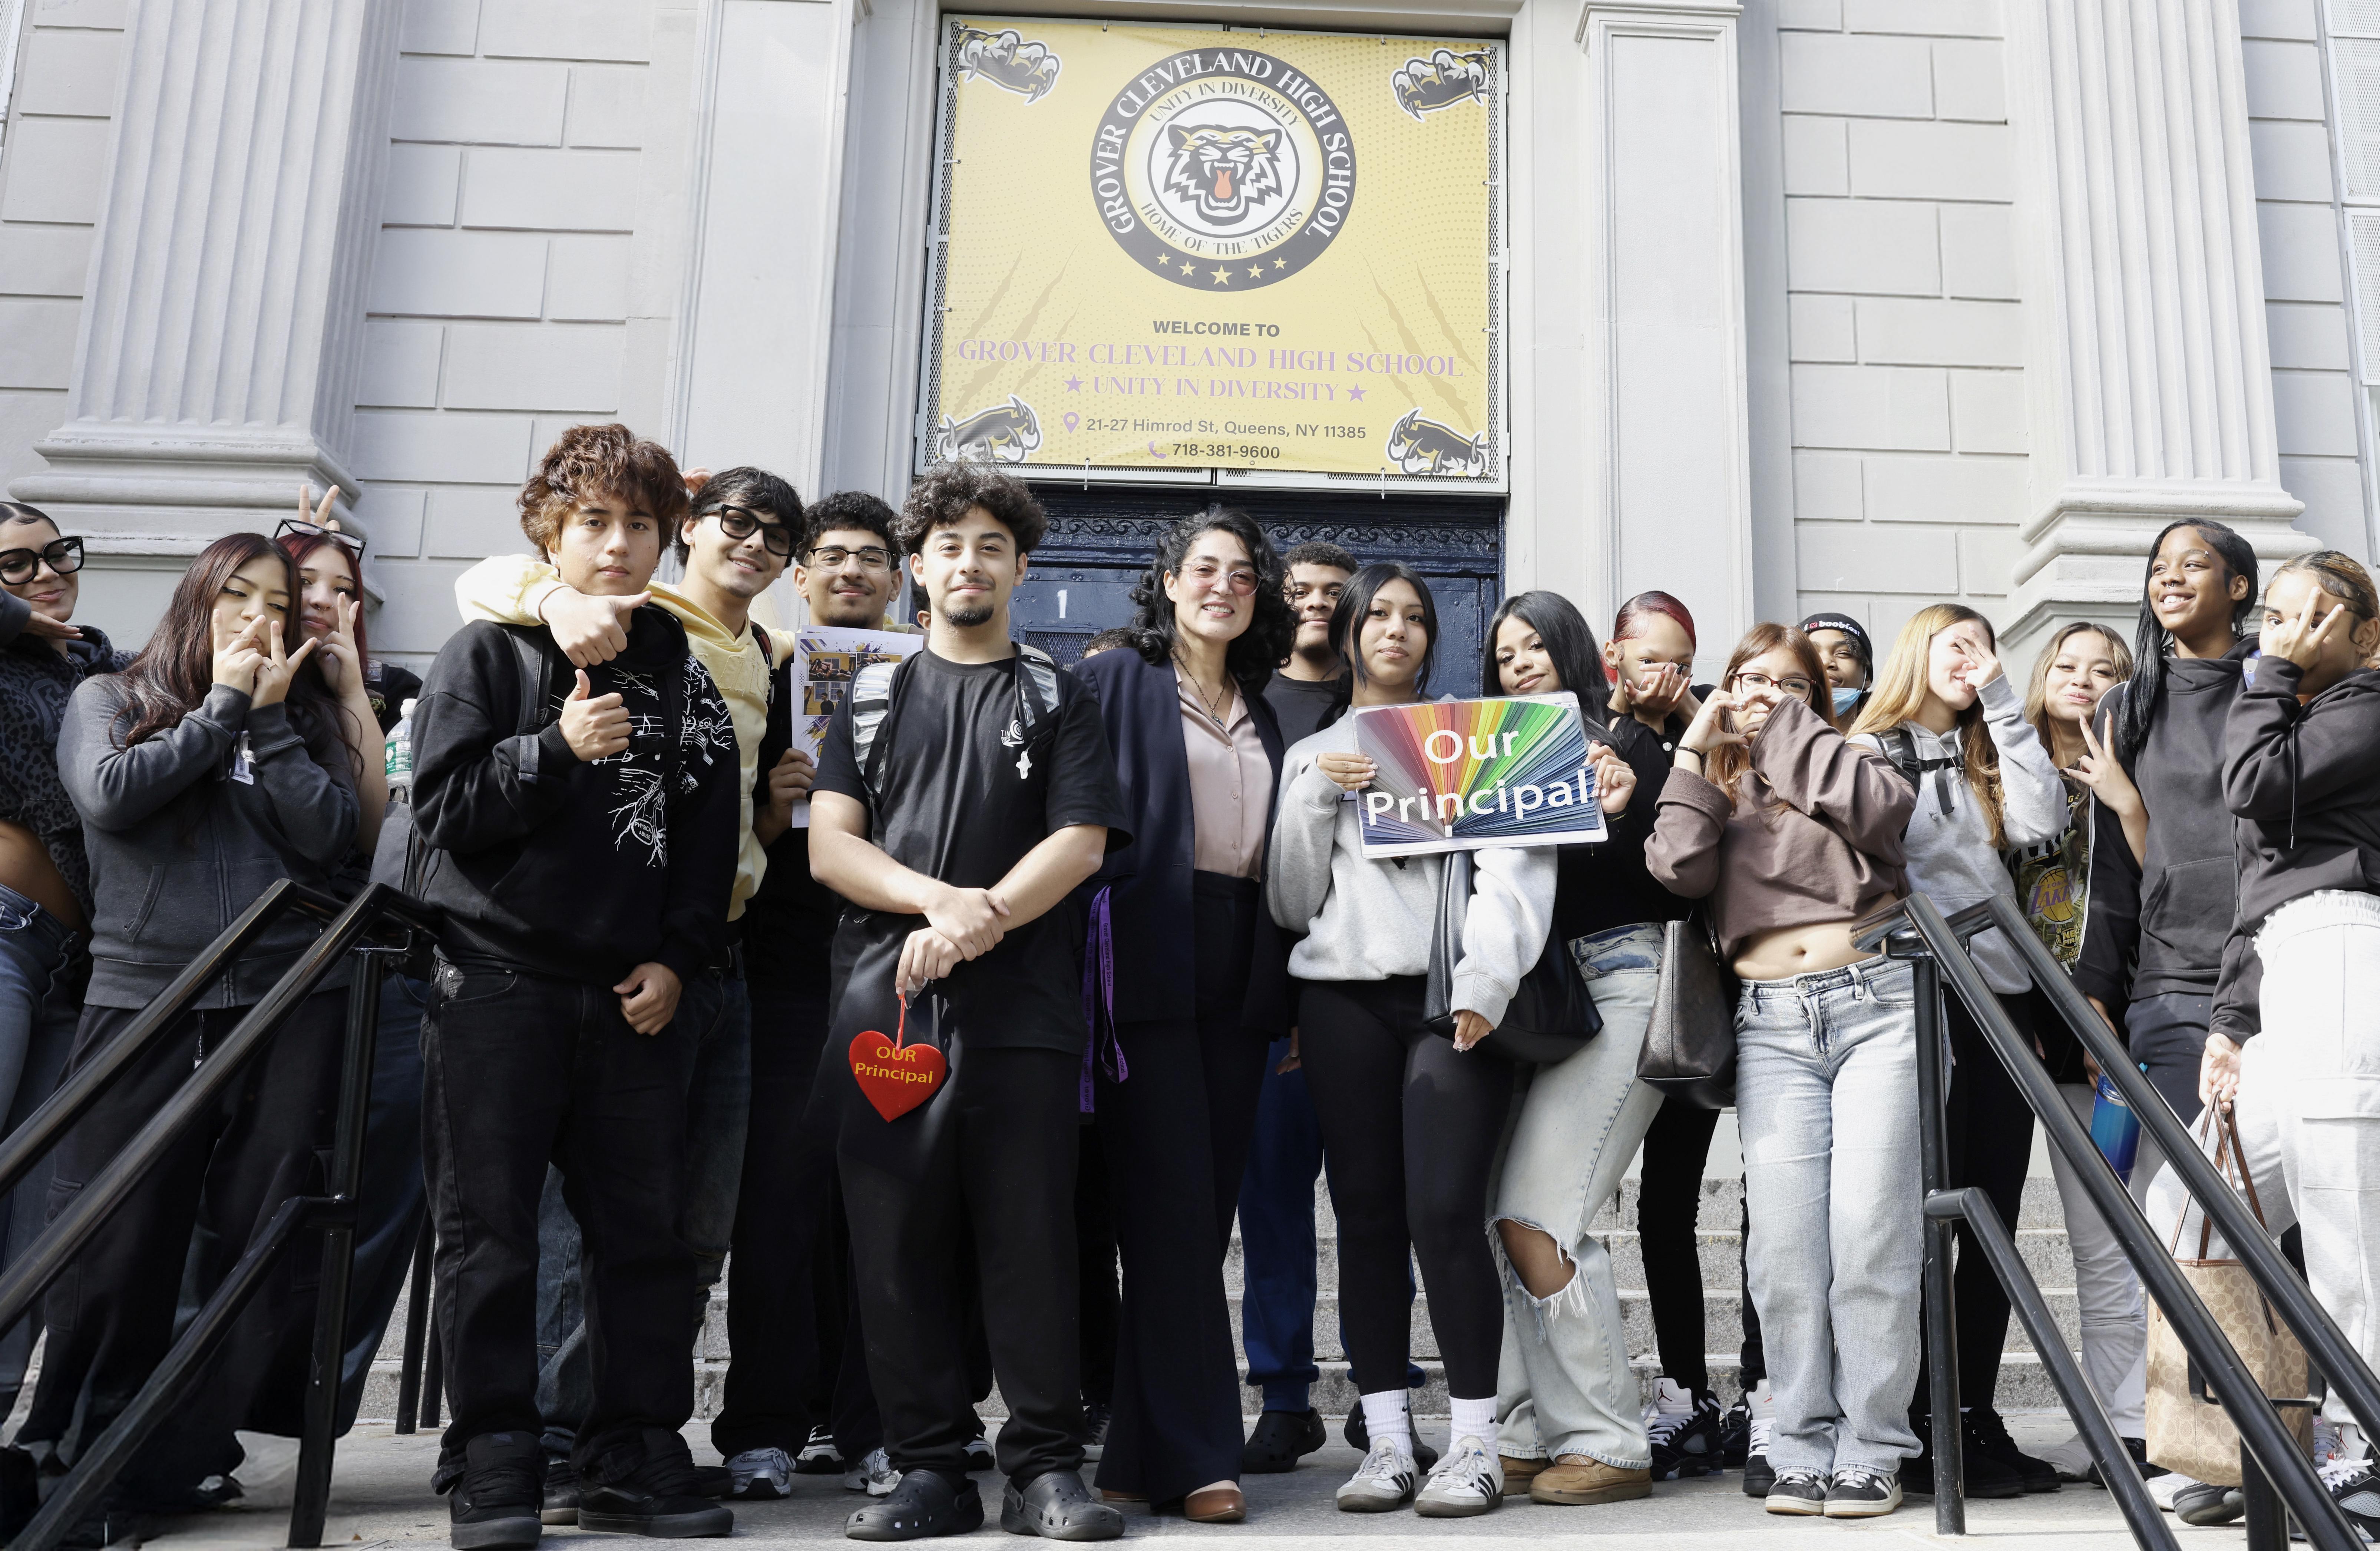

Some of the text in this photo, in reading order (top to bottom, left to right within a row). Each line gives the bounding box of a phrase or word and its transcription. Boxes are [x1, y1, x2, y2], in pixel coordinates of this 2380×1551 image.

[1150, 82, 1302, 126] UNITY IN DIVERSITY
[1095, 52, 1351, 237] GROVER CLEVELAND HIGH SCHOOL
[1141, 202, 1303, 255] HOME OF THE TIGERS
[1153, 320, 1280, 337] WELCOME TO
[958, 339, 1464, 378] GROVER CLEVELAND HIGH SCHOOL
[1093, 376, 1339, 402] UNITY IN DIVERSITY
[1086, 418, 1366, 439] 21-27 Himrod St, Queens, NY 11385
[1173, 443, 1280, 459] 718-381-9600
[1057, 589, 1067, 618] 1
[1819, 620, 1860, 637] boobies!
[1424, 729, 1519, 764] Our
[1366, 769, 1588, 826] Principal
[634, 821, 652, 834] PHYSICAL
[638, 831, 651, 841] ABUSE
[876, 1047, 916, 1062] OUR
[855, 1063, 933, 1084] Principal
